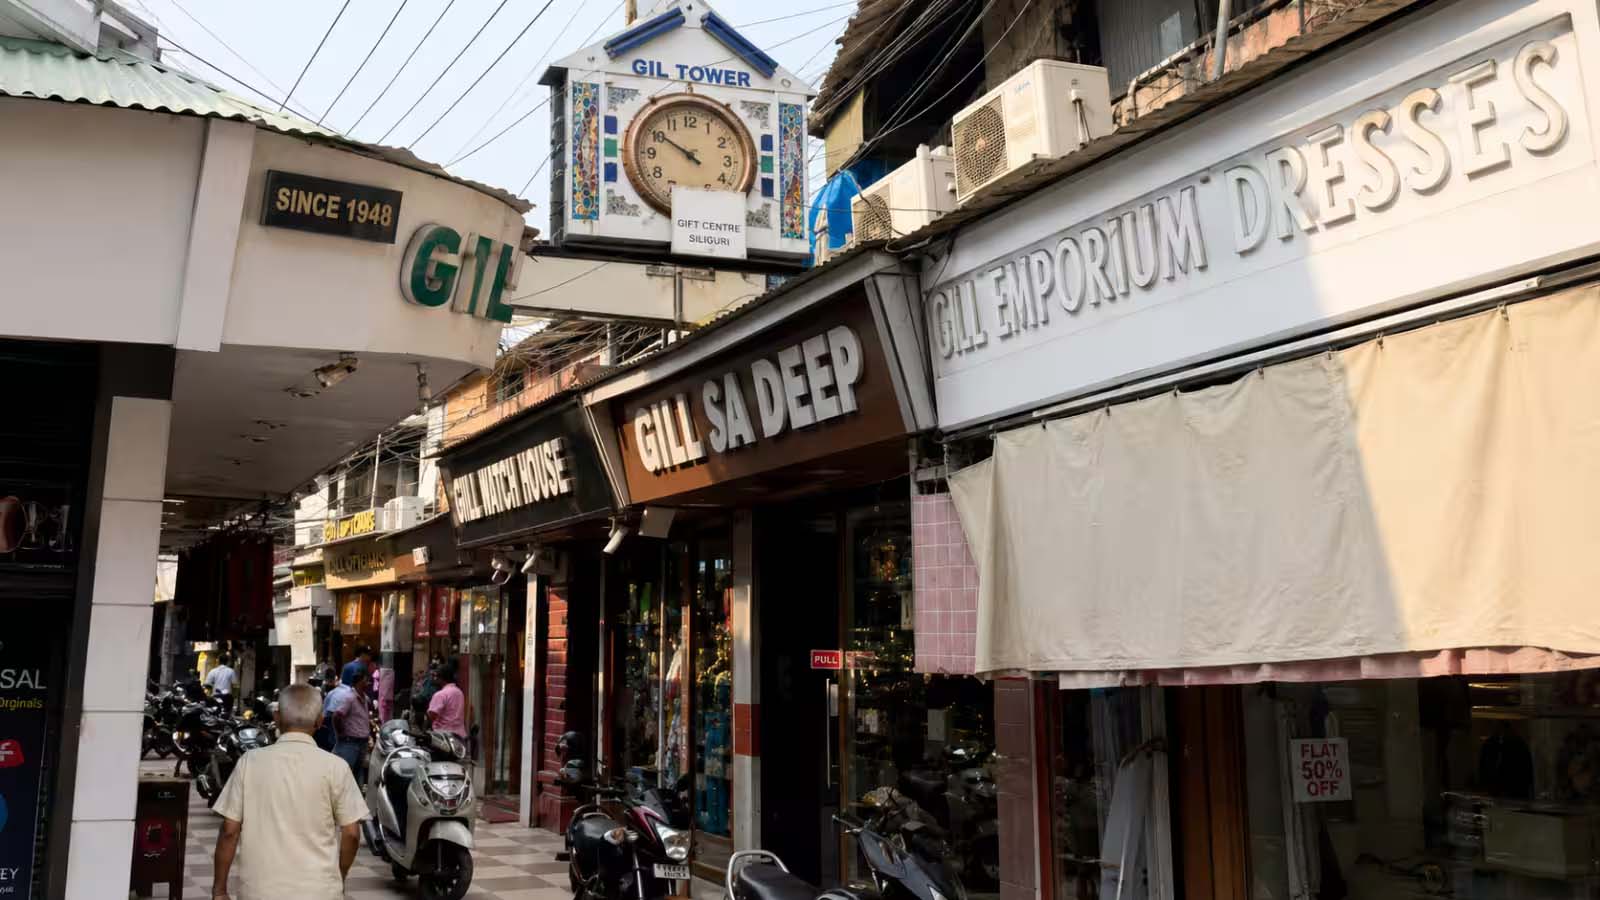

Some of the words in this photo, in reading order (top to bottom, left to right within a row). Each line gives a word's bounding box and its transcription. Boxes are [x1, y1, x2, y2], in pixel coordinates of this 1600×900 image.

[632, 58, 669, 78] GIL
[676, 64, 750, 87] TOWER
[666, 115, 678, 132] 11
[683, 115, 698, 129] 12
[705, 121, 711, 135] 1
[652, 130, 666, 144] 10
[717, 136, 727, 149] 2
[646, 147, 657, 160] 9
[723, 155, 733, 168] 3
[652, 166, 663, 179] 8
[717, 172, 727, 185] 4
[276, 186, 342, 219] SINCE
[346, 198, 393, 227] 1948
[931, 279, 988, 359] GILL
[988, 186, 1209, 339] EMPORIUM
[1223, 40, 1569, 255] DRESSES
[677, 218, 699, 230] GIFT
[702, 221, 741, 233] CENTRE
[688, 234, 730, 247] SILIGURI
[633, 393, 707, 475] GILL
[702, 371, 757, 454] SA
[751, 325, 864, 439] DEEP
[453, 472, 482, 524] GILL
[477, 456, 522, 517] WATCH
[516, 436, 570, 505] HOUSE
[814, 655, 839, 665] PULL
[1301, 743, 1339, 758] FLAT
[1302, 760, 1343, 780] 50%
[1307, 780, 1339, 797] OFF
